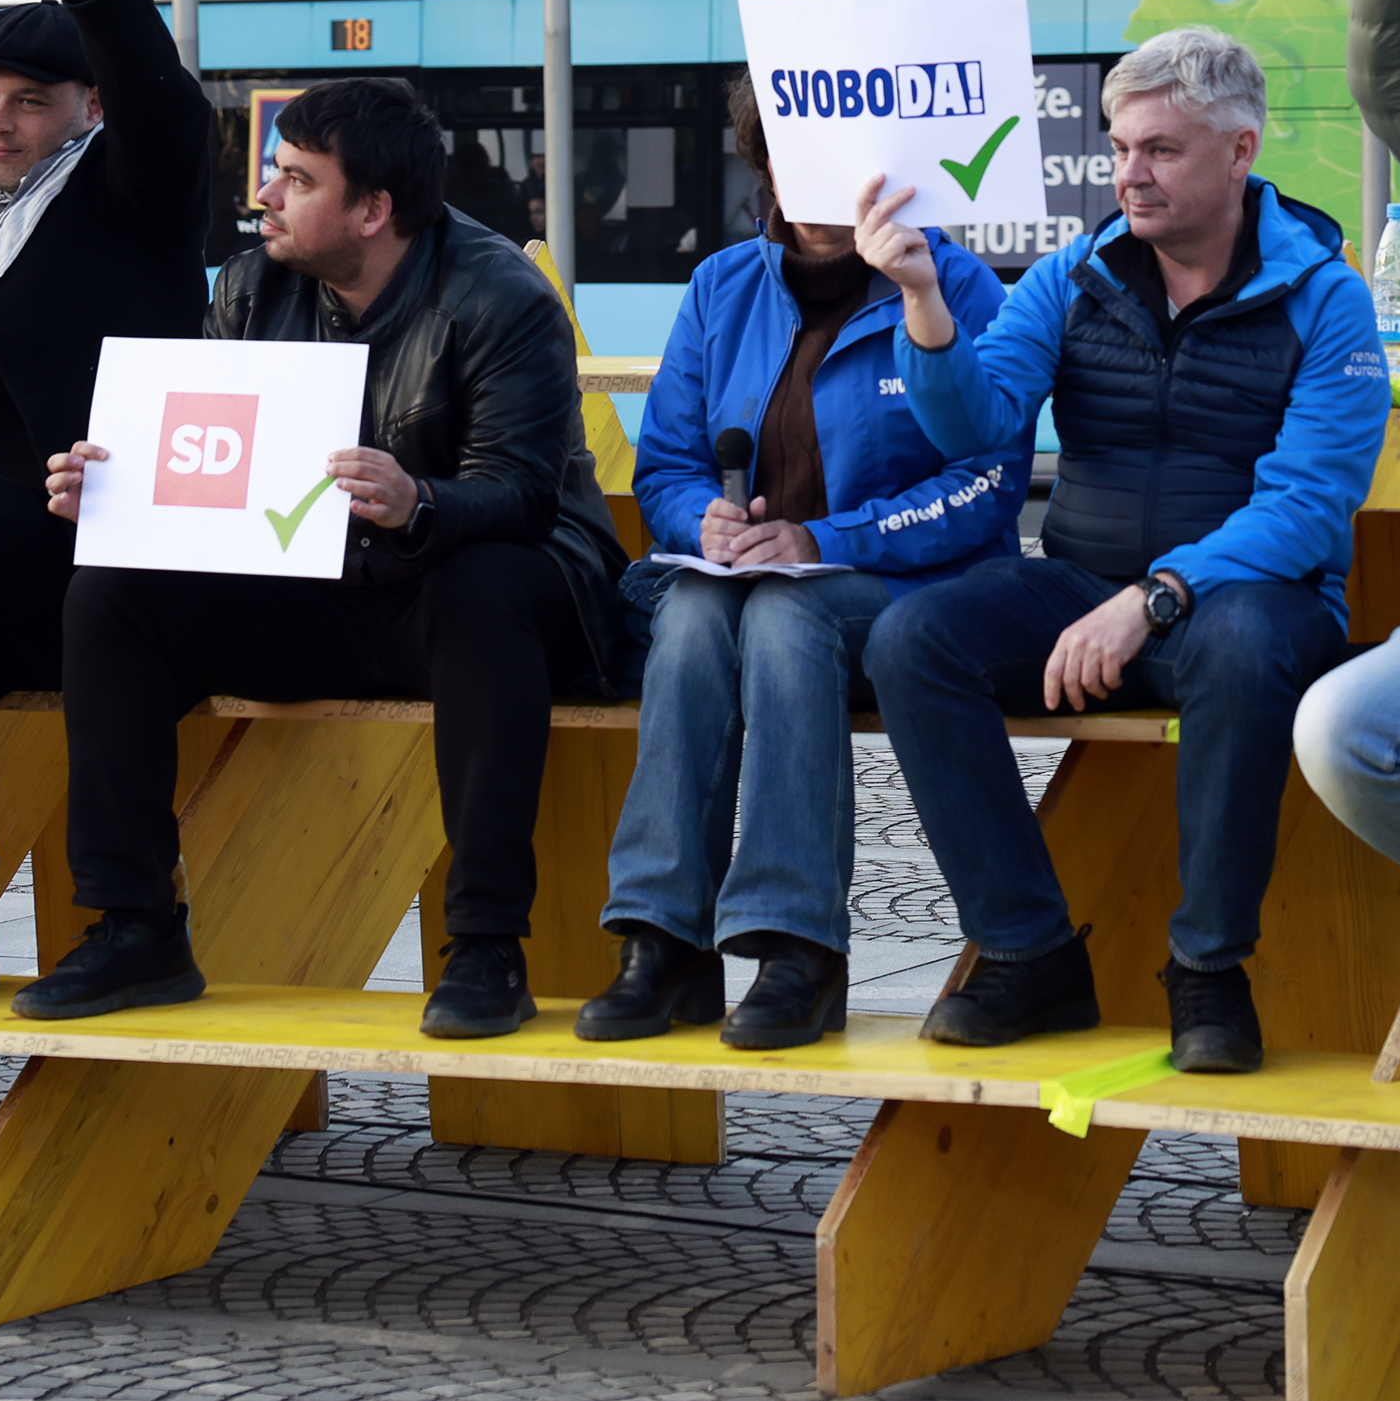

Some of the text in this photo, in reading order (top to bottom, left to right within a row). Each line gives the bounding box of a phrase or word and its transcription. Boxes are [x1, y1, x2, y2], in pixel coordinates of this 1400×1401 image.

[343, 19, 371, 50] 18
[771, 61, 985, 118] SVOBODA!
[1043, 154, 1116, 187] sve
[166, 423, 243, 475] SD
[878, 498, 946, 534] renew
